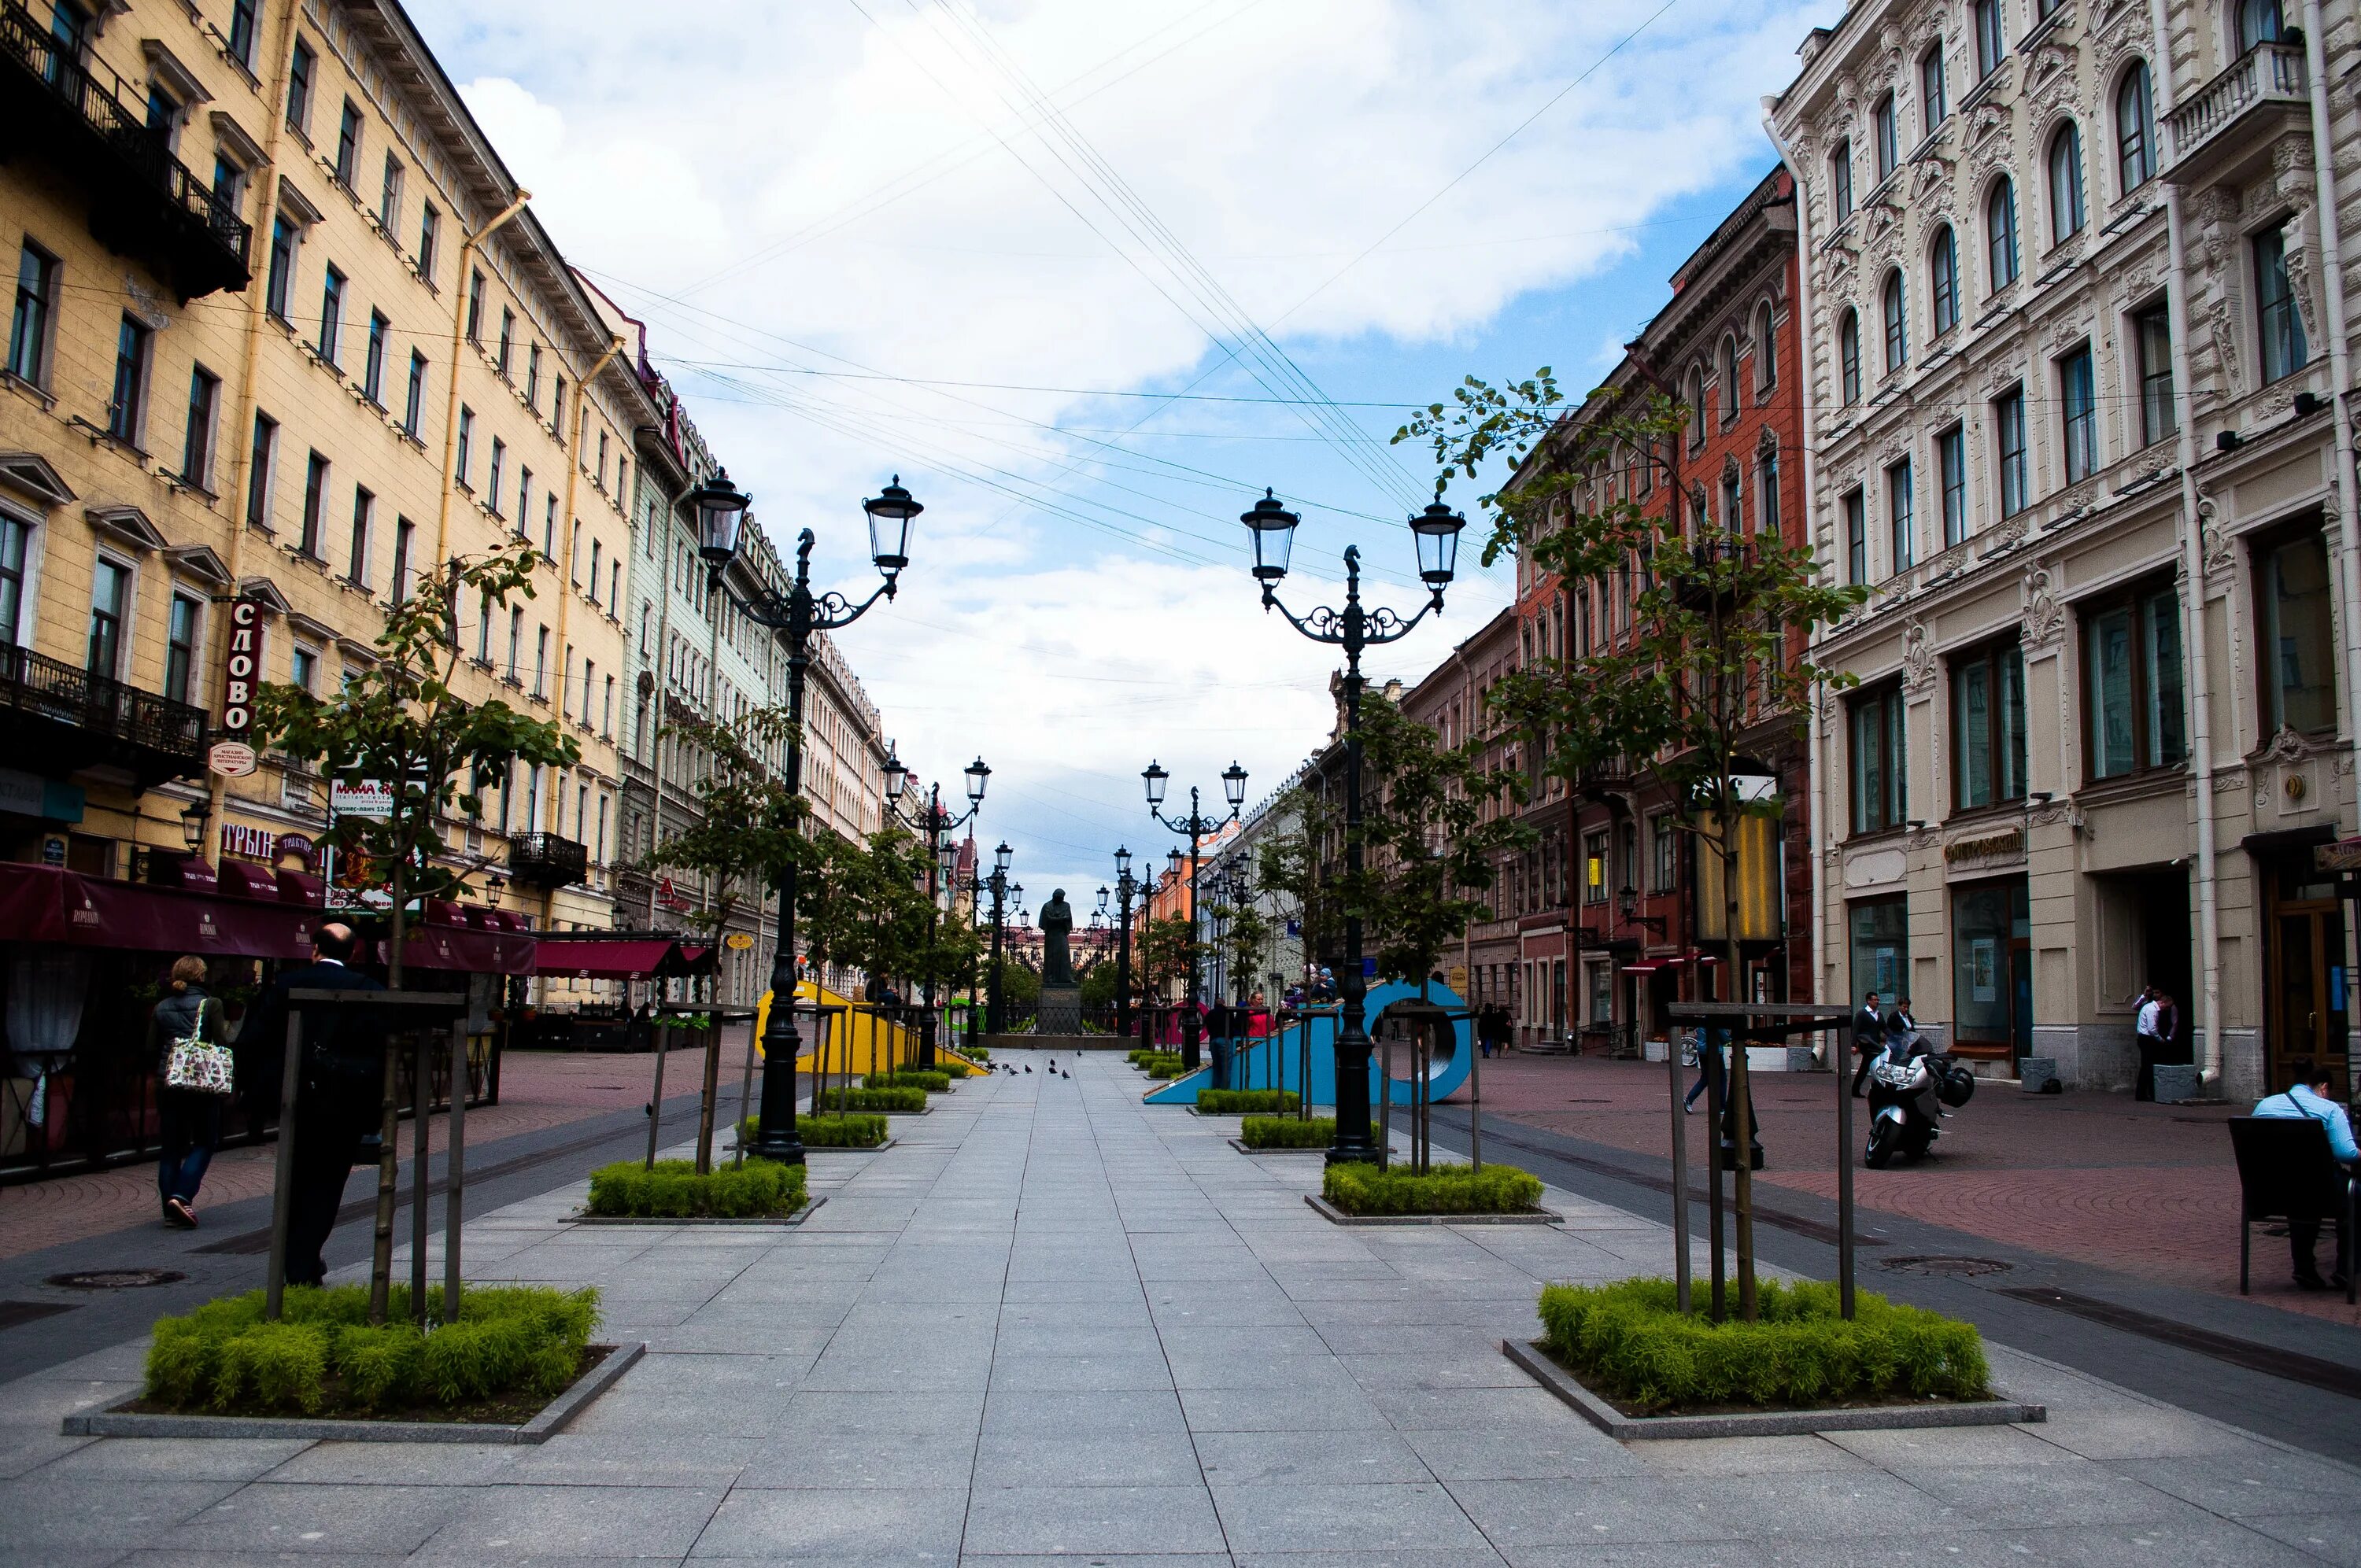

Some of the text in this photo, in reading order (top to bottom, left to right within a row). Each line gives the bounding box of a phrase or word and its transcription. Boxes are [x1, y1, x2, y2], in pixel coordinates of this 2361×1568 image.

[226, 603, 255, 729] СЛОВО
[223, 824, 273, 858] ТРЫН
[283, 837, 312, 853] ТРАКТИР
